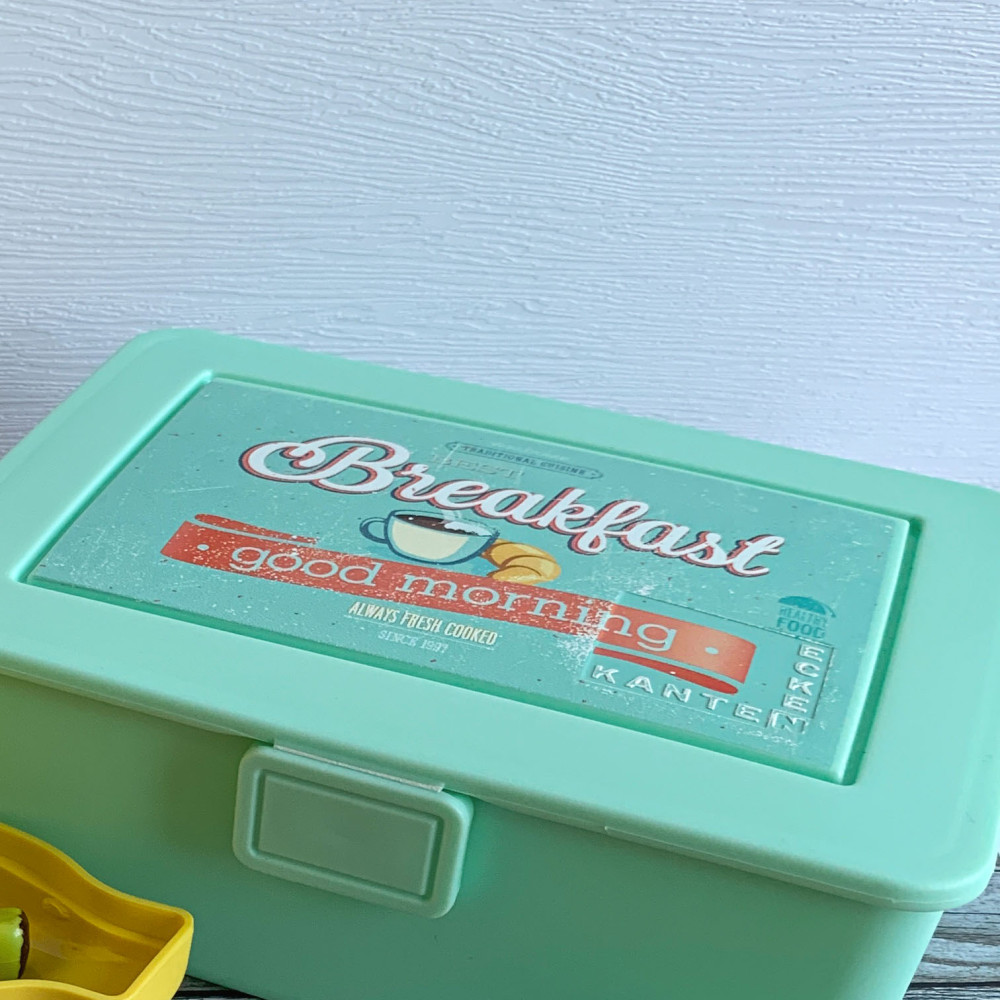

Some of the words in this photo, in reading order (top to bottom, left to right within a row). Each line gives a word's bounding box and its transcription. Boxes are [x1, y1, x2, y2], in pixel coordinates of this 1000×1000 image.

[239, 436, 785, 577] Breakfast
[230, 546, 385, 588] good
[400, 572, 679, 652] morning
[348, 600, 400, 624] ALWAYS
[400, 610, 443, 634] FRESH
[443, 621, 498, 646] COOKED
[377, 629, 419, 648] SINCE
[775, 616, 826, 639] FOOD
